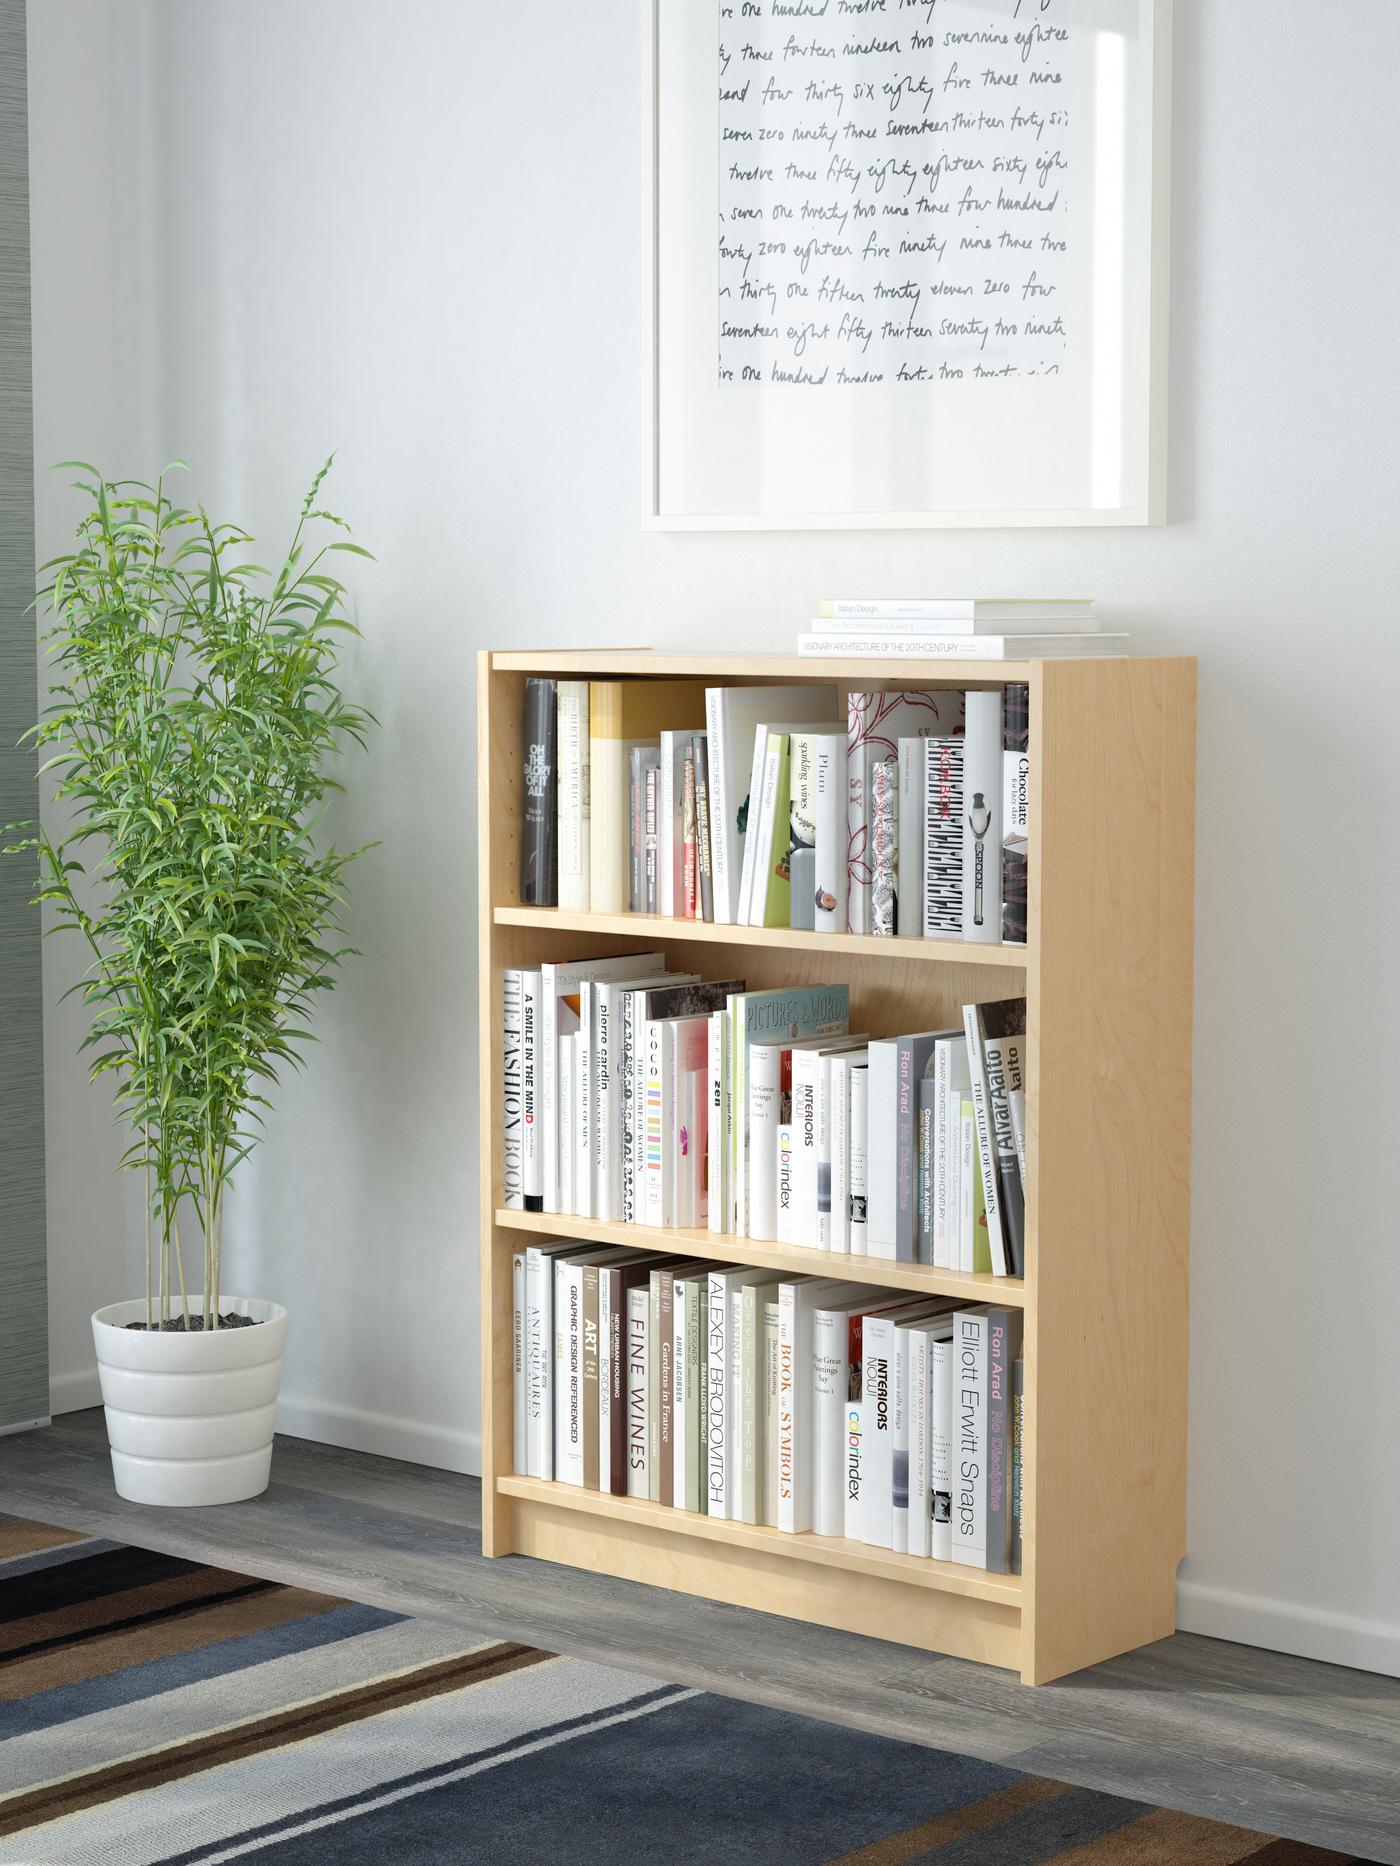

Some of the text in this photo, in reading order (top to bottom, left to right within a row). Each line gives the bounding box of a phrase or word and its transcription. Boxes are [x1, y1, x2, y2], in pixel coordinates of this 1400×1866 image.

[742, 0, 829, 17] one hundred
[741, 30, 933, 61] three fourteen nineteen two
[762, 61, 1062, 117] four thirty six eighty five three nine
[759, 106, 1044, 152] zero ninety three thirteen forty
[729, 149, 1027, 196] twelve three fifty eighty eighteen sixty
[731, 185, 1059, 236] seven one twenty two nine three four hundred
[758, 226, 1032, 274] zero eighteen five ninety nine three
[739, 271, 1056, 321] thirty one twenty eleven zero four
[787, 312, 1017, 356] eight fifty thirteen two
[742, 360, 963, 385] one hundred two
[857, 605, 877, 614] Design
[530, 744, 545, 754] OH
[712, 732, 720, 785] ARCHITECTURE
[819, 754, 828, 792] Plum
[765, 758, 776, 808] Italian Design
[799, 742, 810, 810] sparkling wines
[940, 745, 950, 820] KOKBOK
[1010, 790, 1018, 804] lazy
[1018, 758, 1029, 825] Chocolate
[1010, 806, 1018, 825] days
[975, 850, 984, 890] SPOON
[747, 996, 848, 1032] PICTURES WORDS
[525, 994, 534, 1124] A SMILE IN THE MIND
[600, 1005, 610, 1090] pierre cardin
[504, 974, 520, 1204] THE FASHION BOOK
[796, 1084, 804, 1118] NOW!
[638, 1119, 644, 1130] OF
[804, 1084, 814, 1147] INTERIORS
[899, 1049, 910, 1210] Ron Arad No Discipline
[939, 1134, 946, 1145] OF
[780, 1132, 792, 1209] colorindex
[924, 1108, 932, 1232] Conversations with Architects
[963, 1143, 971, 1168] Design
[974, 1080, 996, 1214] THE ALLURE OF WOMEN
[584, 1318, 598, 1354] ART
[824, 1357, 842, 1365] Great
[531, 1307, 540, 1418] ANTIQUAIRES
[570, 1285, 578, 1444] GRAPHIC DESIGN REFERENCED
[600, 1358, 609, 1416] BORDEAUX
[780, 1344, 792, 1392] BOOK
[867, 1356, 877, 1396] NOW!
[630, 1320, 645, 1471] FINE WINES
[662, 1342, 671, 1442] Gardens in France
[710, 1280, 724, 1503] ALEXEY BRODOVITCH
[878, 1358, 888, 1431] INTERIORS
[958, 1320, 980, 1536] Elliott Erwitt Snaps
[989, 1326, 1003, 1512] Ron Arad No Discipline
[780, 1412, 792, 1500] SYMBOLS
[848, 1411, 862, 1501] colorindex
